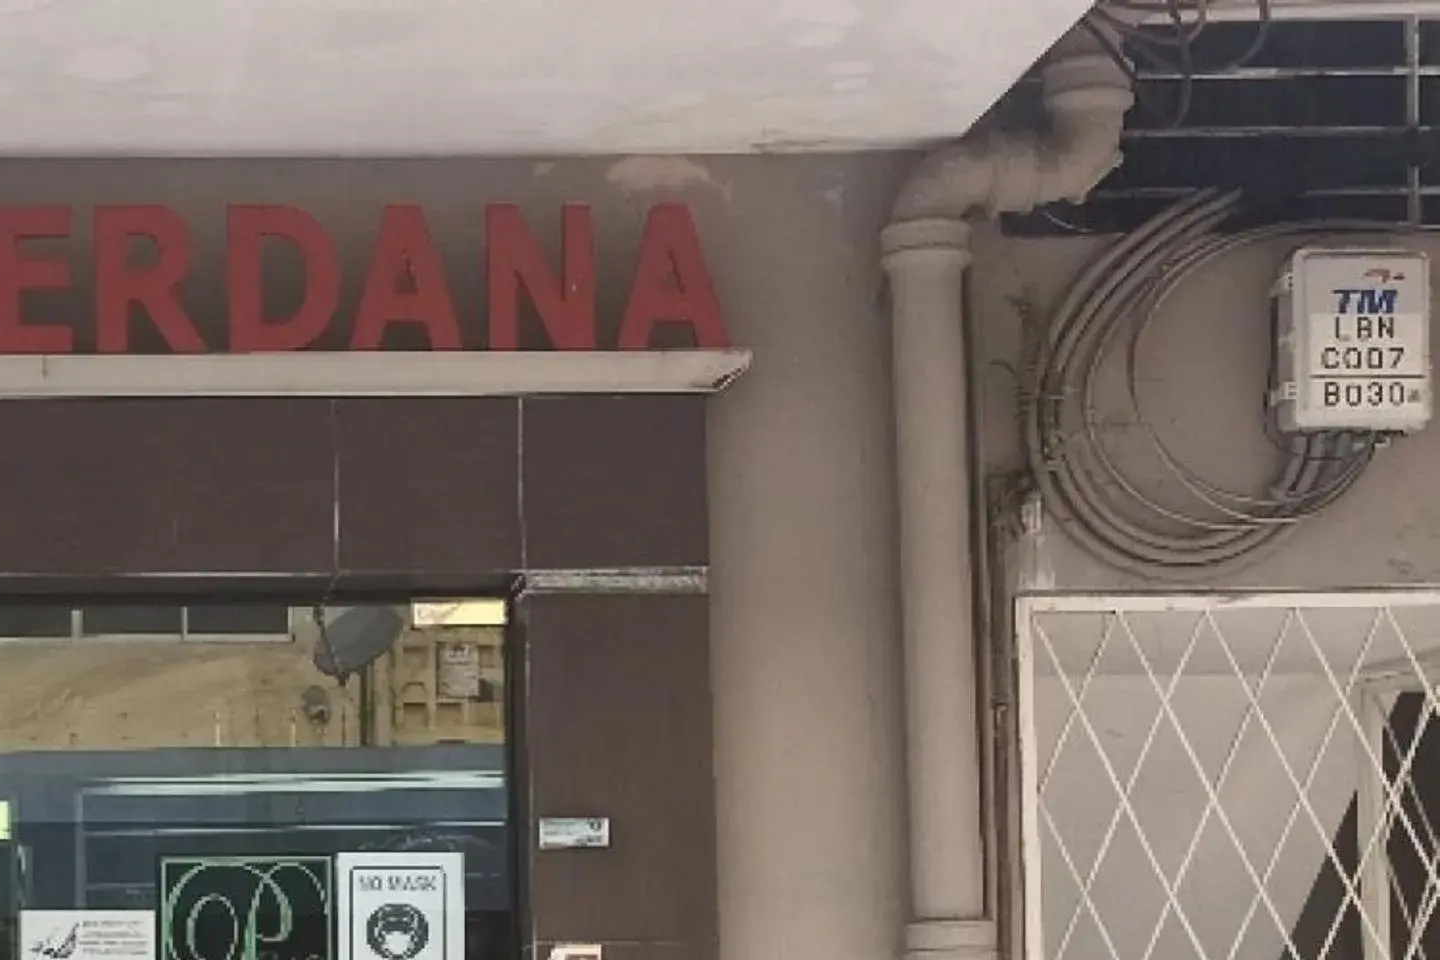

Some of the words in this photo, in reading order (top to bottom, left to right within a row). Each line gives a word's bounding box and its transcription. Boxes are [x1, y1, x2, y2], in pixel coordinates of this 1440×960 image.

[1332, 289, 1398, 314] TM
[1335, 316, 1394, 341] LBN
[1324, 381, 1405, 407] B030
